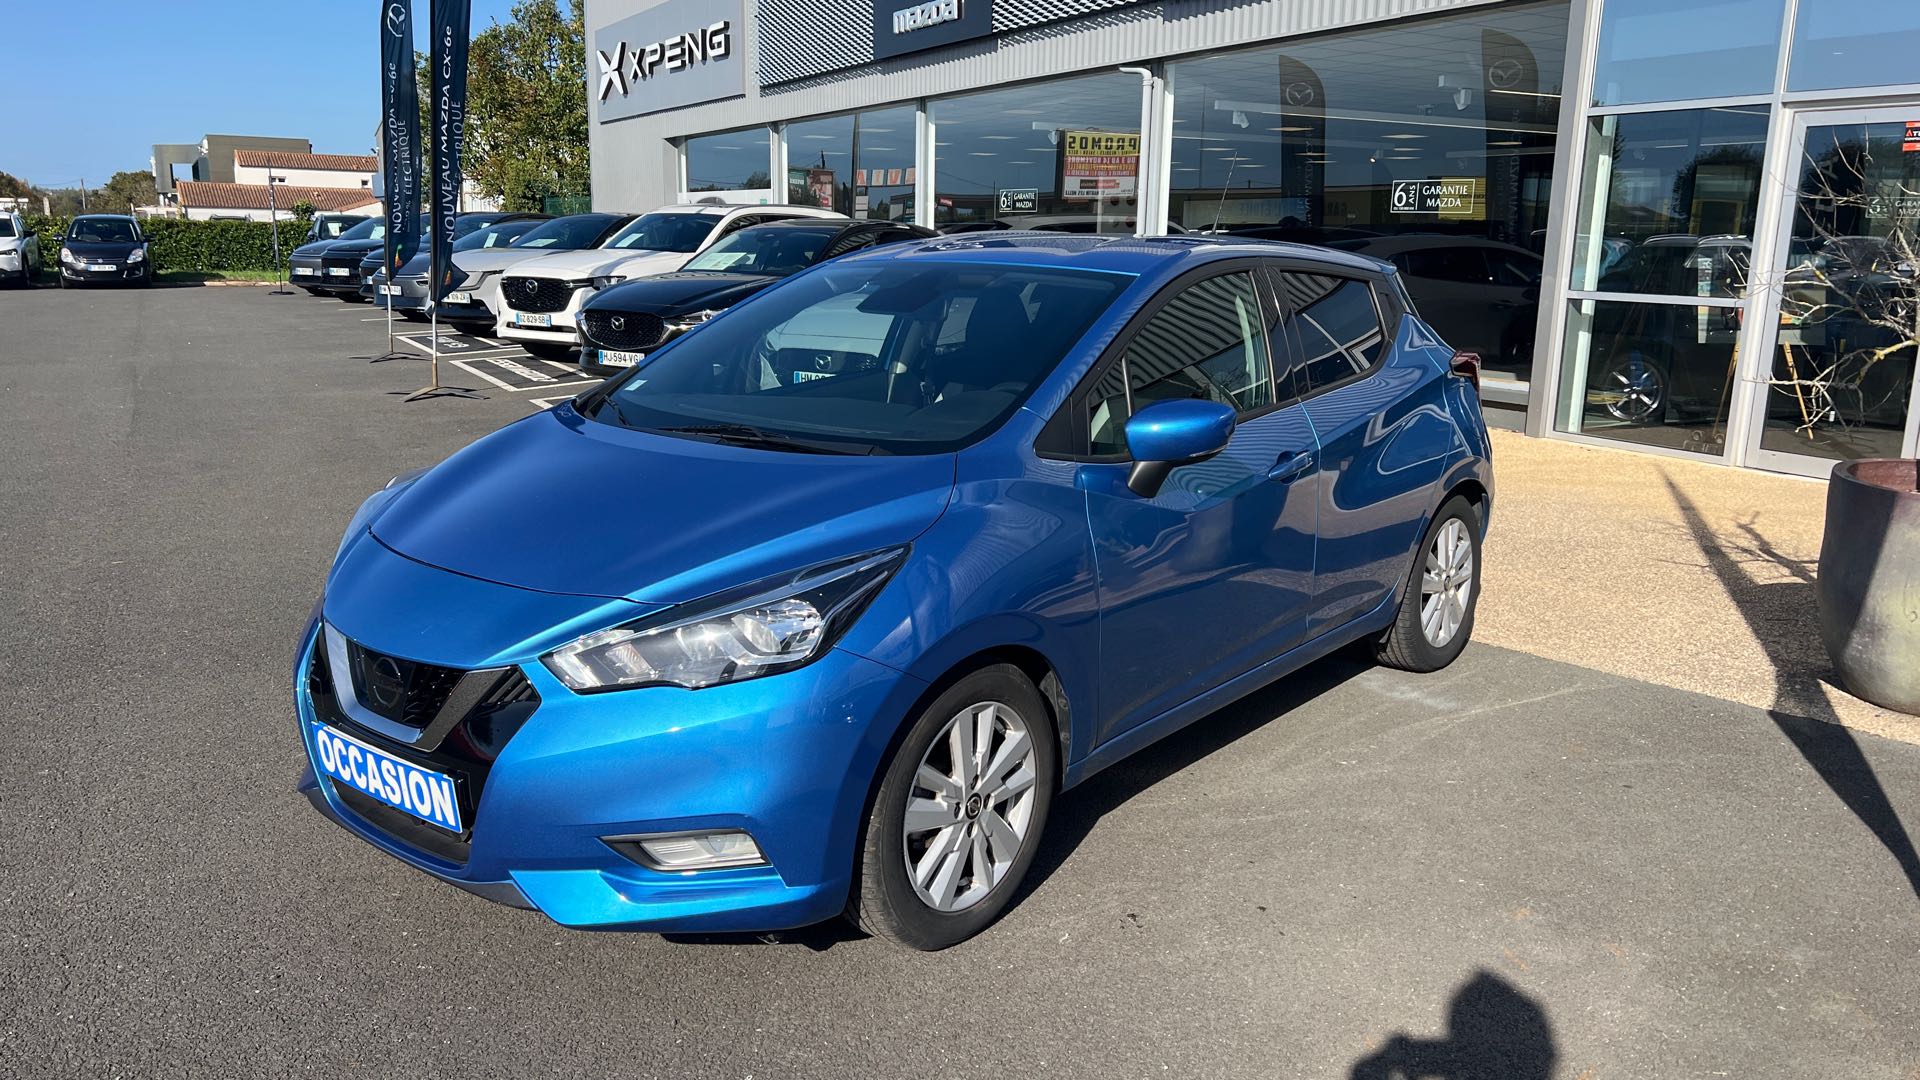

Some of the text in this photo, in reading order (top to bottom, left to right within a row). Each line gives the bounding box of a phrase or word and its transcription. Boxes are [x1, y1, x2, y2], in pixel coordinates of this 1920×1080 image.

[628, 20, 730, 80] XPENG
[441, 26, 455, 242] NOUVEAU MAZDA CX-6e
[392, 166, 402, 233] NOUVE
[1394, 182, 1406, 207] 6
[1422, 185, 1468, 195] GARANTIE
[1426, 198, 1462, 207] MAZDA
[316, 729, 456, 827] OCCASION
